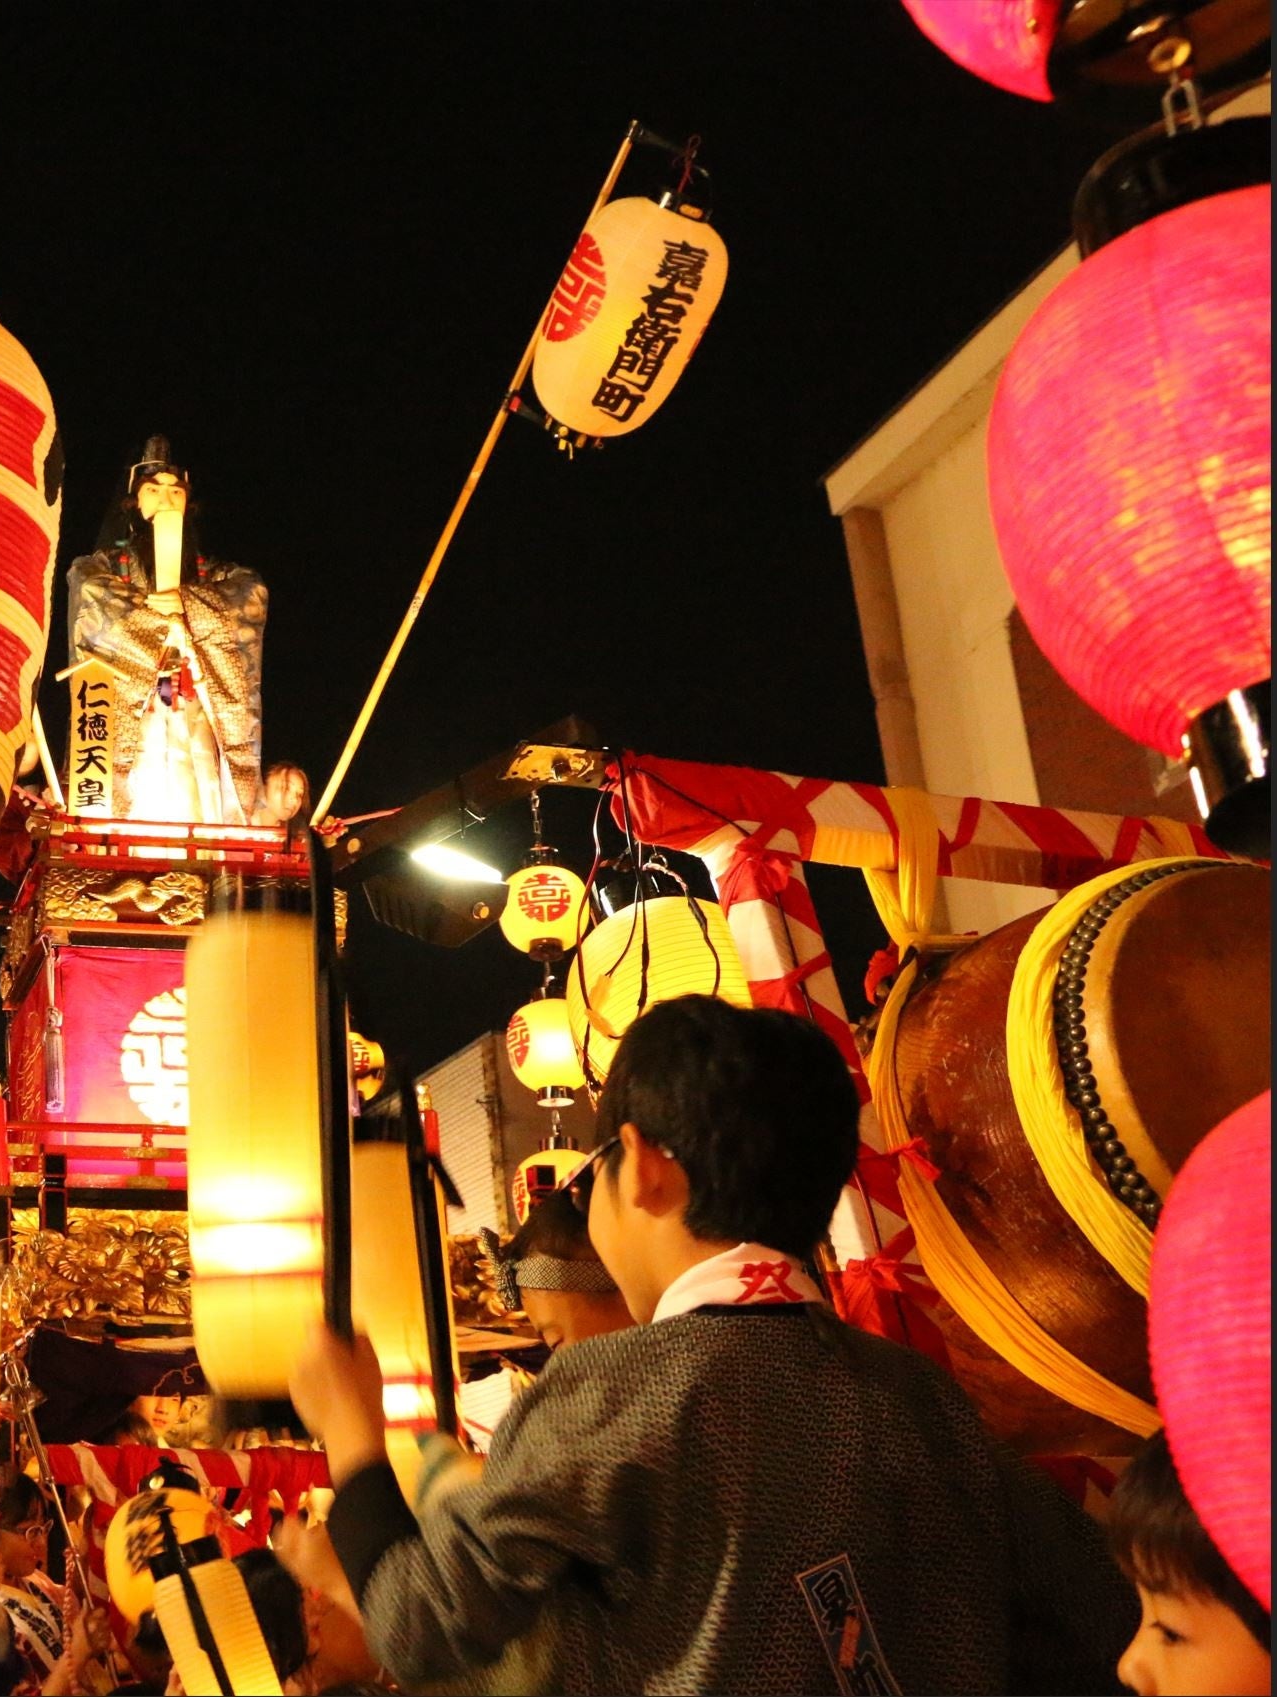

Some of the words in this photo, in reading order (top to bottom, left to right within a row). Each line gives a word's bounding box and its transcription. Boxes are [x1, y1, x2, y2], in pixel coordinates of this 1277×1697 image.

[591, 239, 709, 422] 嘉右衛門町
[75, 680, 111, 808] 仁徳天皇
